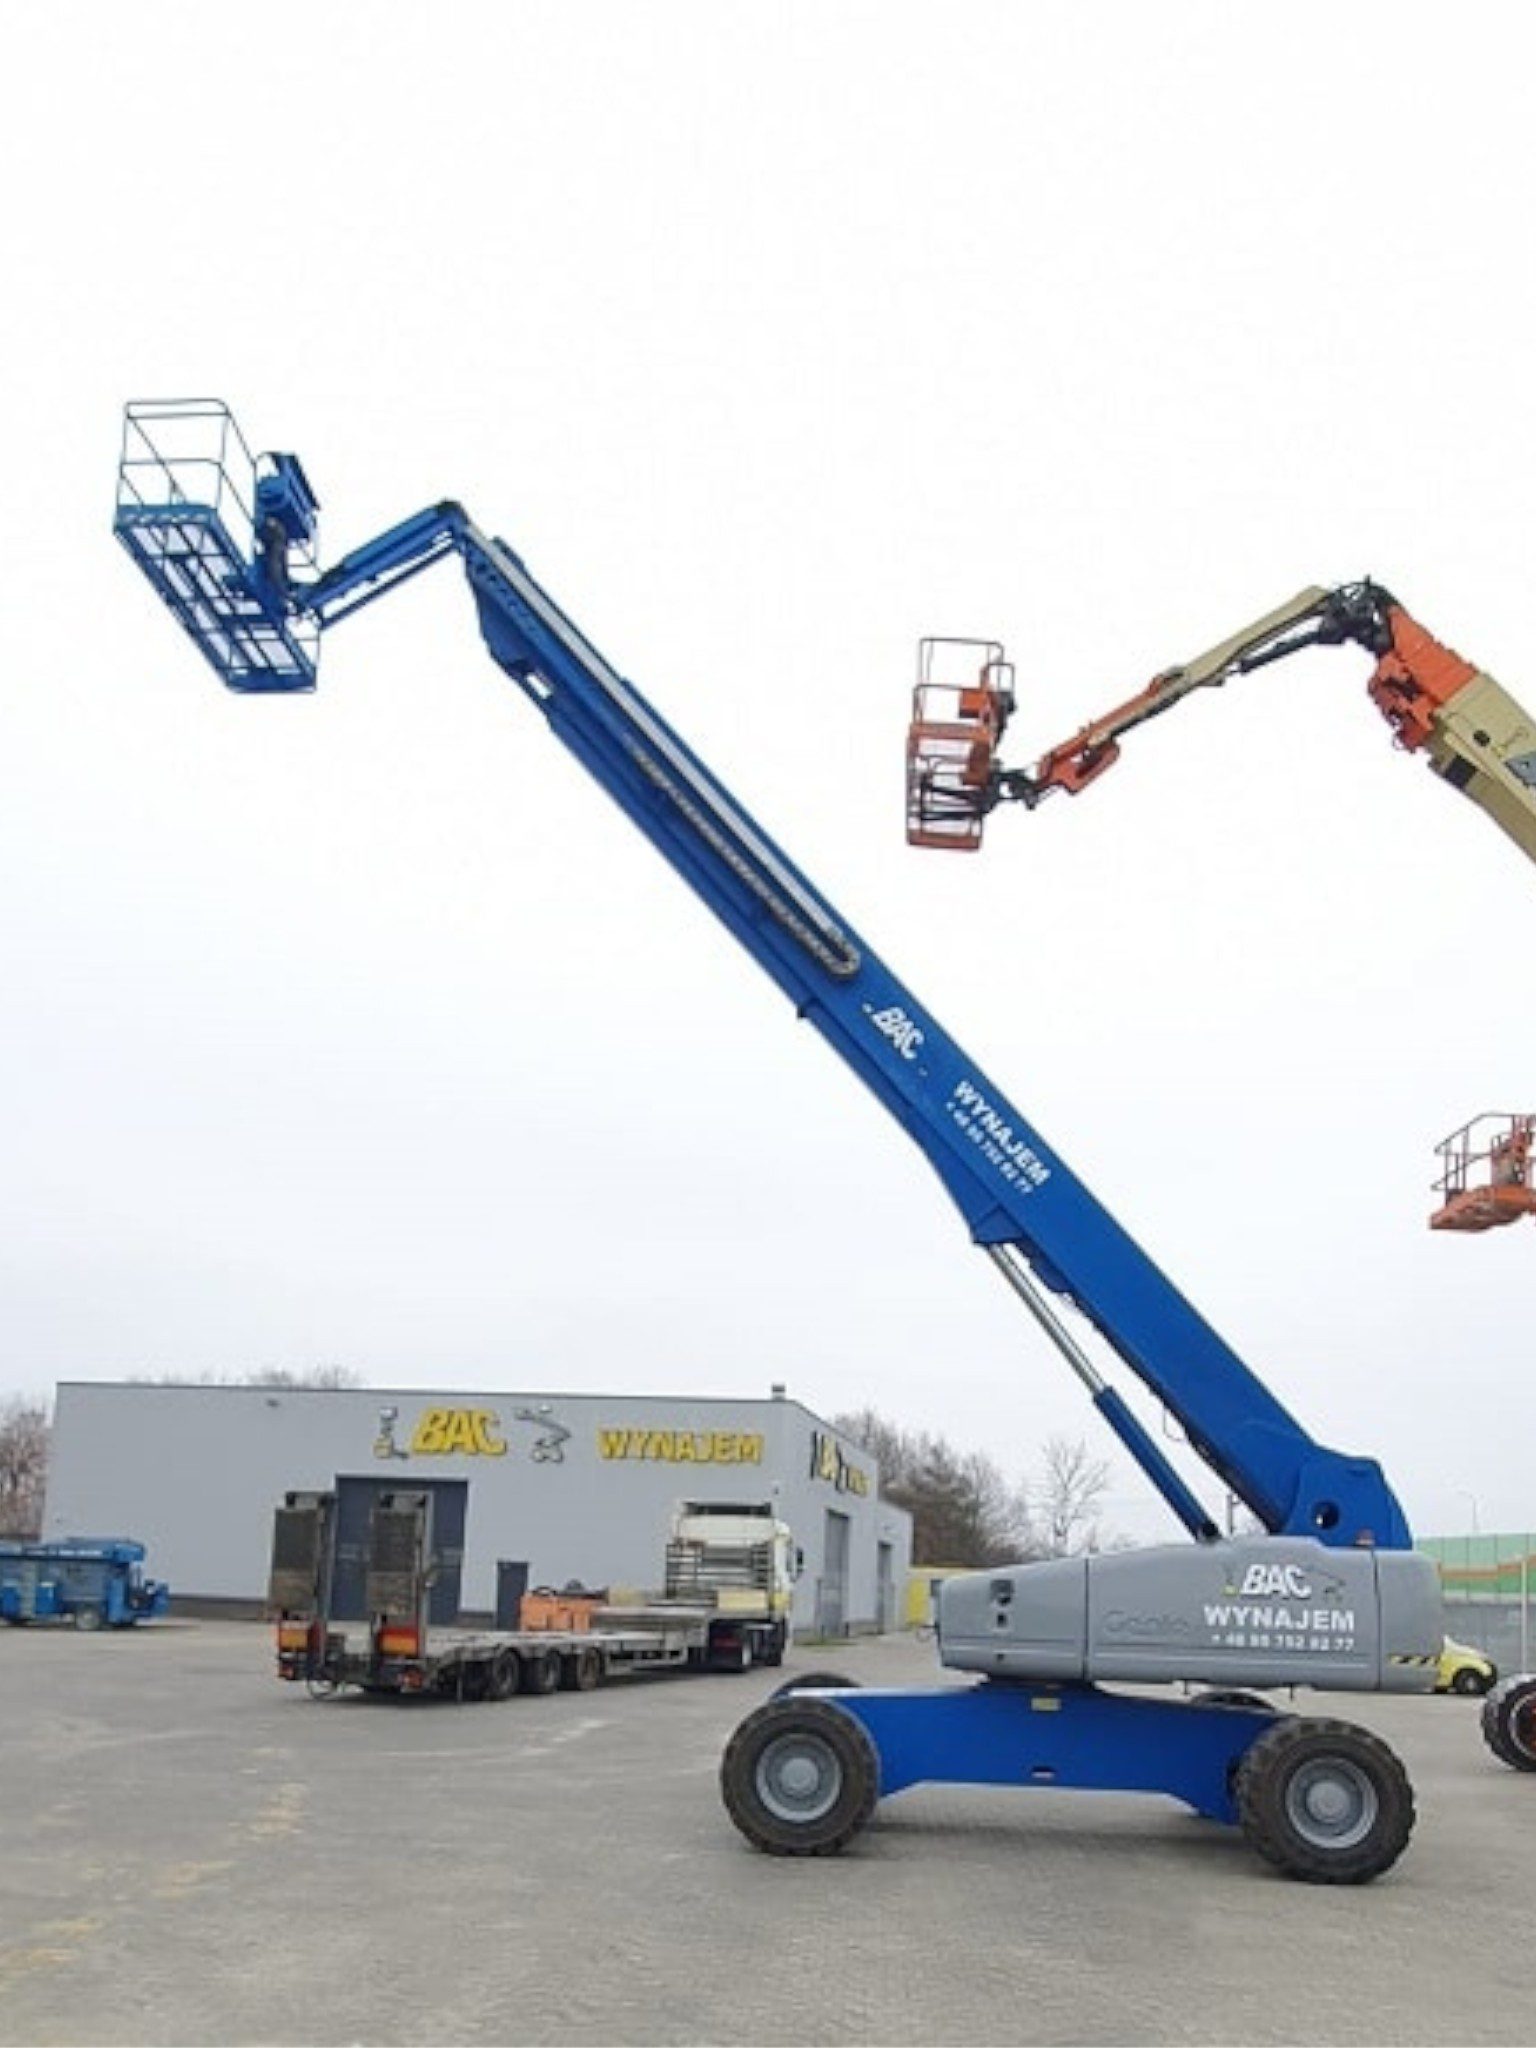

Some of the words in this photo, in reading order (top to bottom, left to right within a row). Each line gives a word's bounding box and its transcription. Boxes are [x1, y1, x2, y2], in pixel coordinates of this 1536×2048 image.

[872, 1006, 924, 1060] BAC
[953, 1080, 1051, 1186] WYNAJEM
[412, 1408, 506, 1455] BAC
[599, 1430, 763, 1465] WYNAJEM
[1240, 1563, 1312, 1599] BAC
[1203, 1605, 1355, 1633] WYNAJEM
